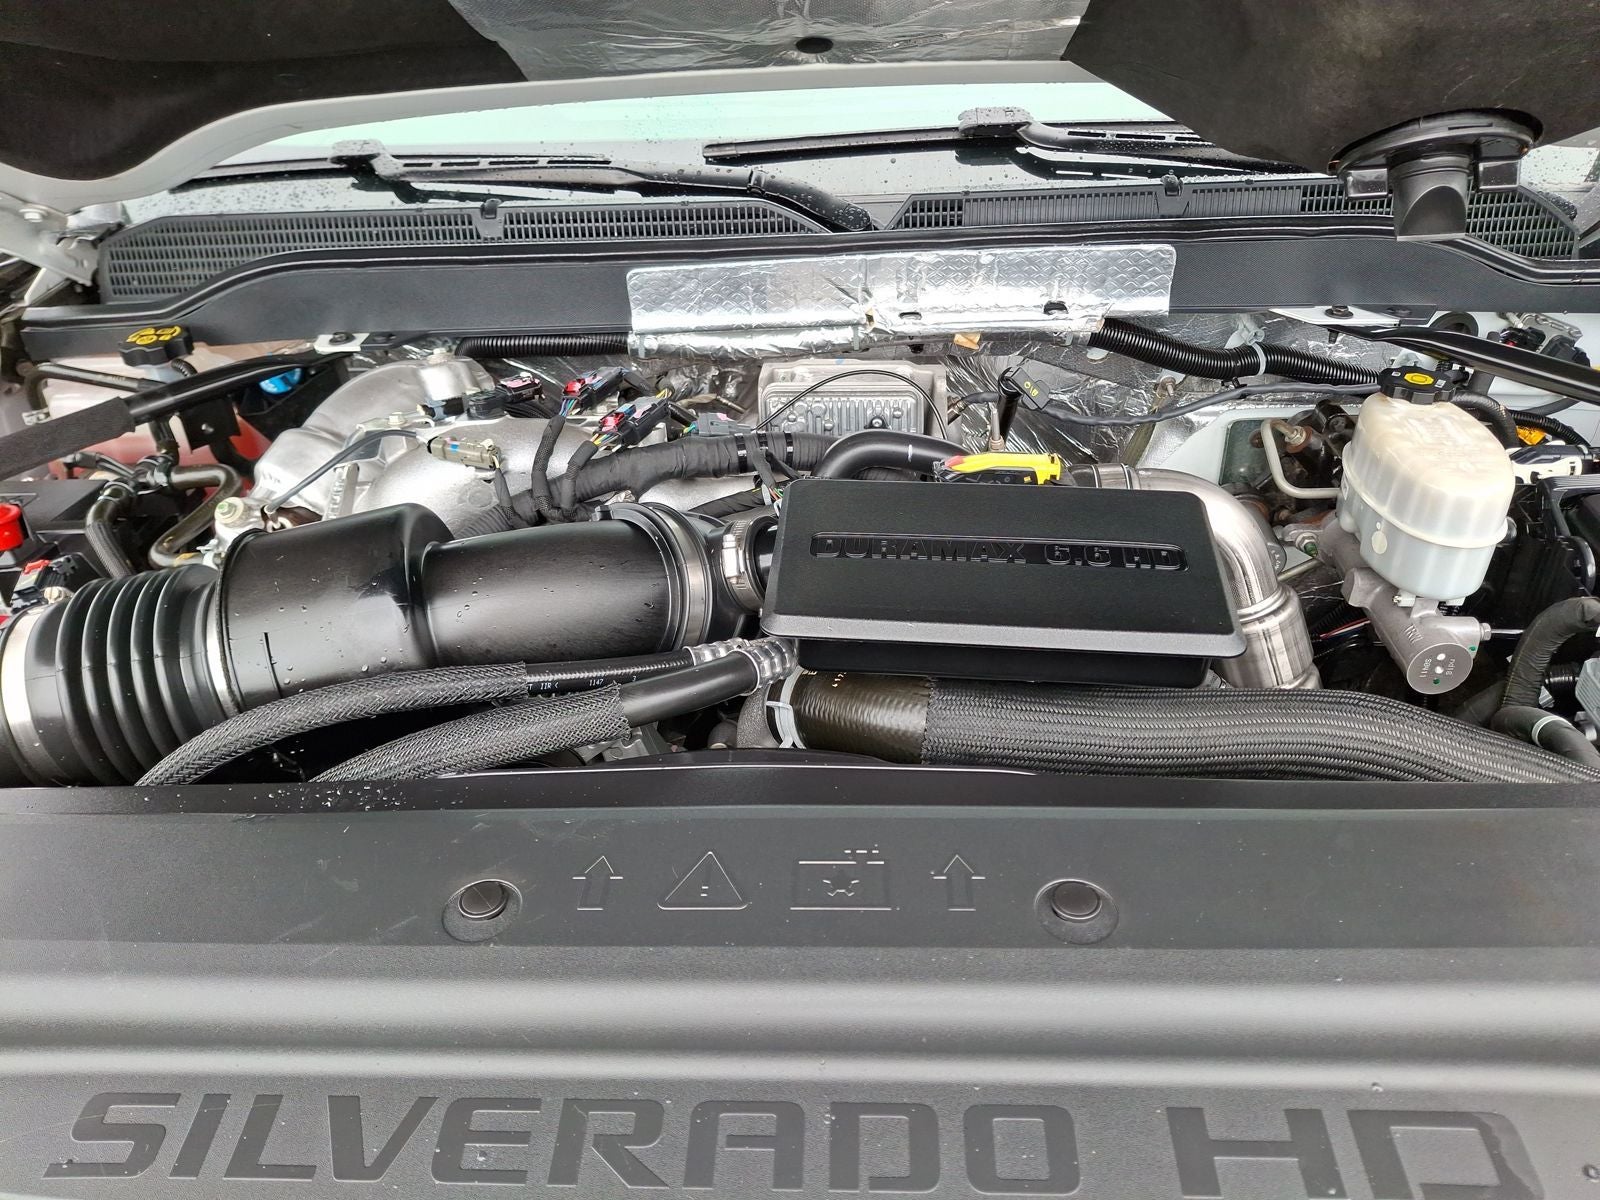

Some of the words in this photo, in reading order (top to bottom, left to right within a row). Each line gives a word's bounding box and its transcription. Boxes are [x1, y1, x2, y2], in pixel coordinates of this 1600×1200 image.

[814, 538, 1027, 564] DURAMAX
[1044, 544, 1112, 568] 6.6
[1122, 546, 1184, 571] HD
[42, 1092, 1081, 1195] SILVERADO
[1165, 1106, 1546, 1200] HD
